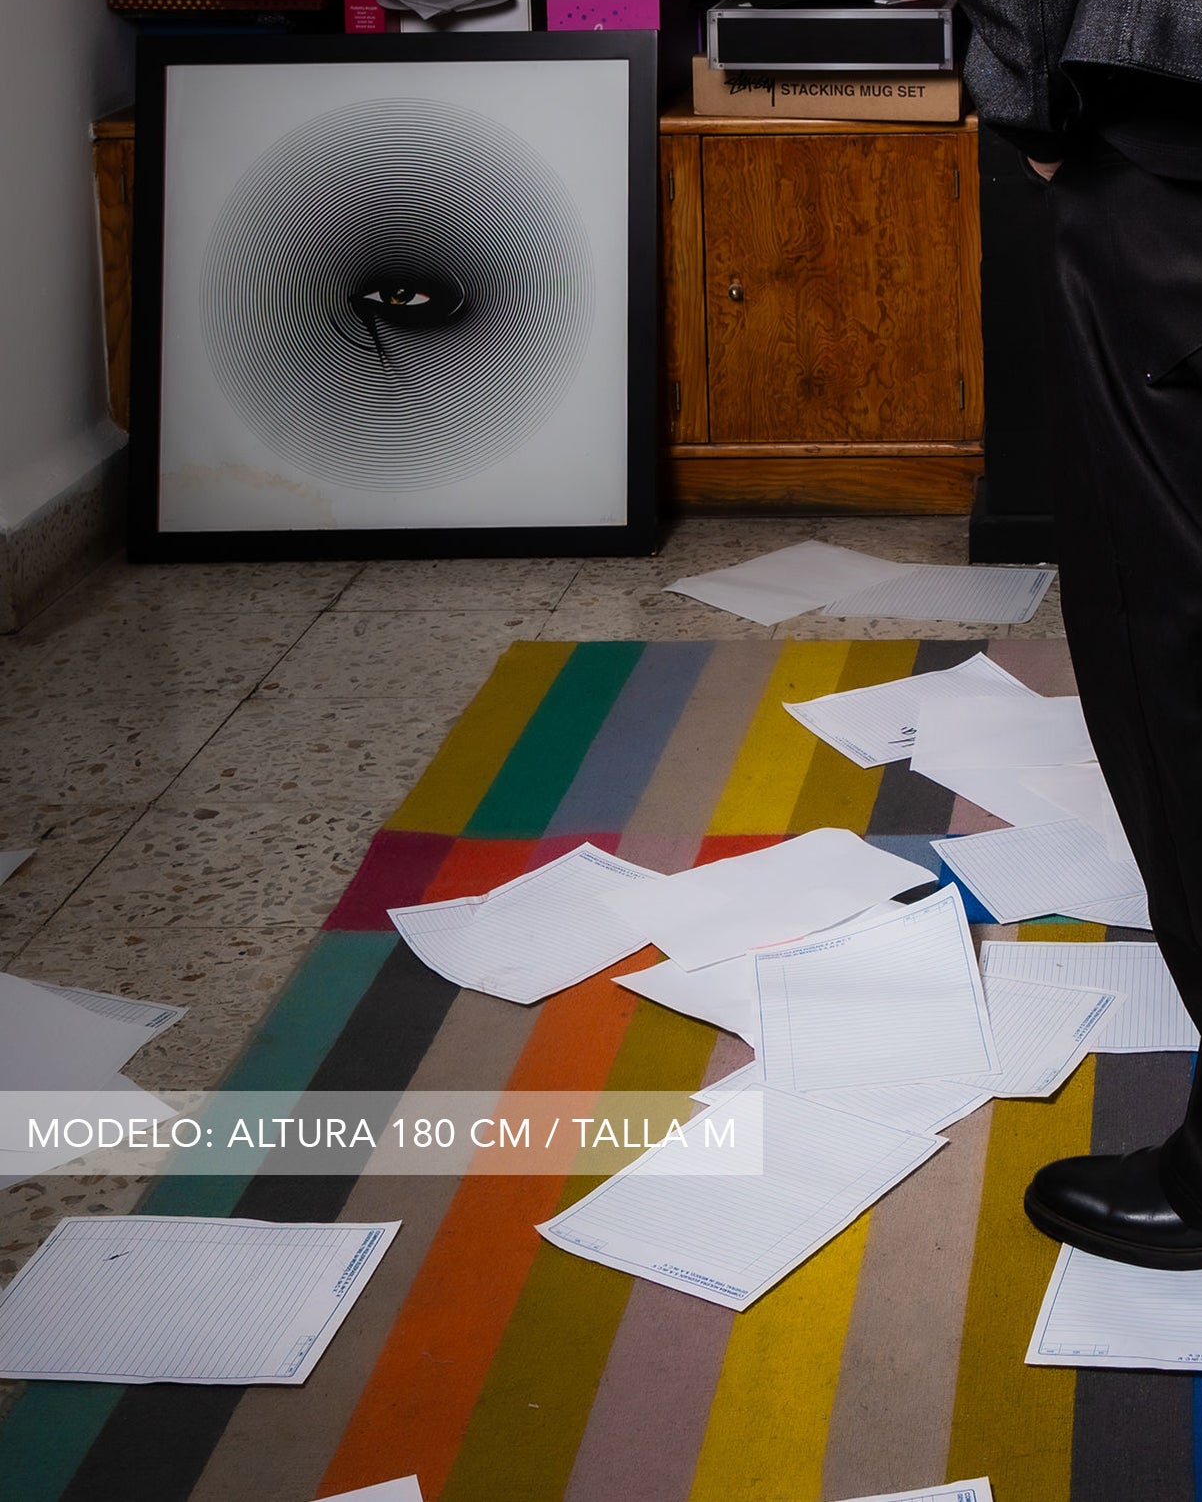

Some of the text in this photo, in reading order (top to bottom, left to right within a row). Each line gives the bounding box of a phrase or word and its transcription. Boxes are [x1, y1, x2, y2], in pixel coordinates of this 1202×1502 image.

[781, 84, 855, 96] STACKING
[860, 85, 893, 97] MUG
[897, 85, 926, 98] SET
